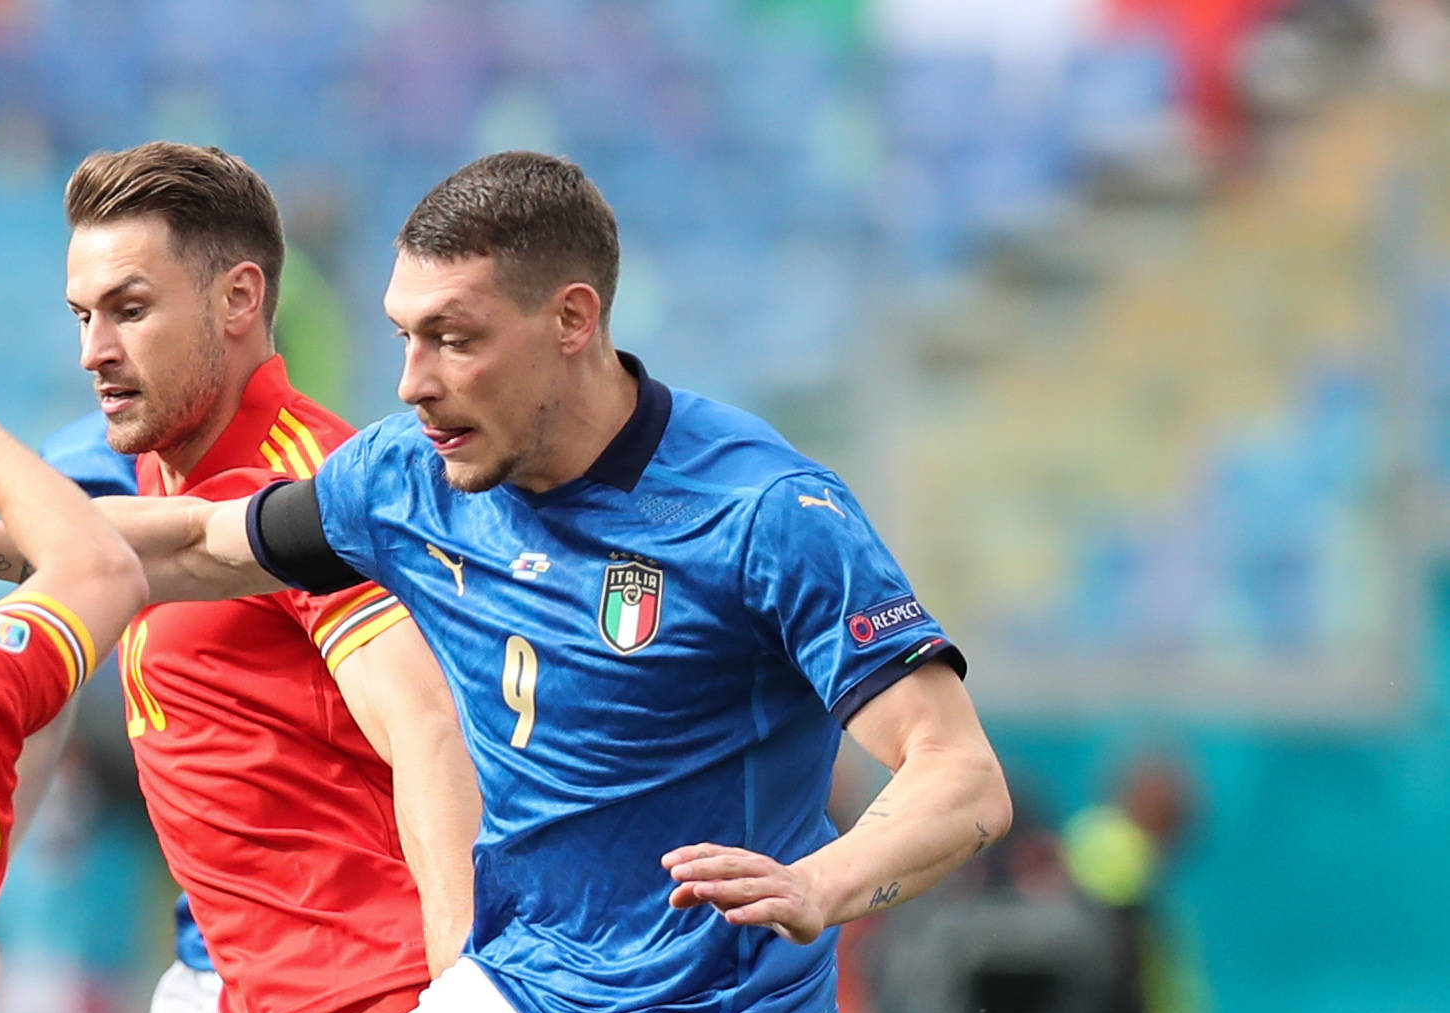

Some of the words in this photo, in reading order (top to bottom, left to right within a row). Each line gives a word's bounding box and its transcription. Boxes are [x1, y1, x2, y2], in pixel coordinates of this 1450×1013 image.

[610, 570, 657, 588] ITALIA
[871, 601, 922, 631] RESPECT
[502, 634, 538, 749] 9
